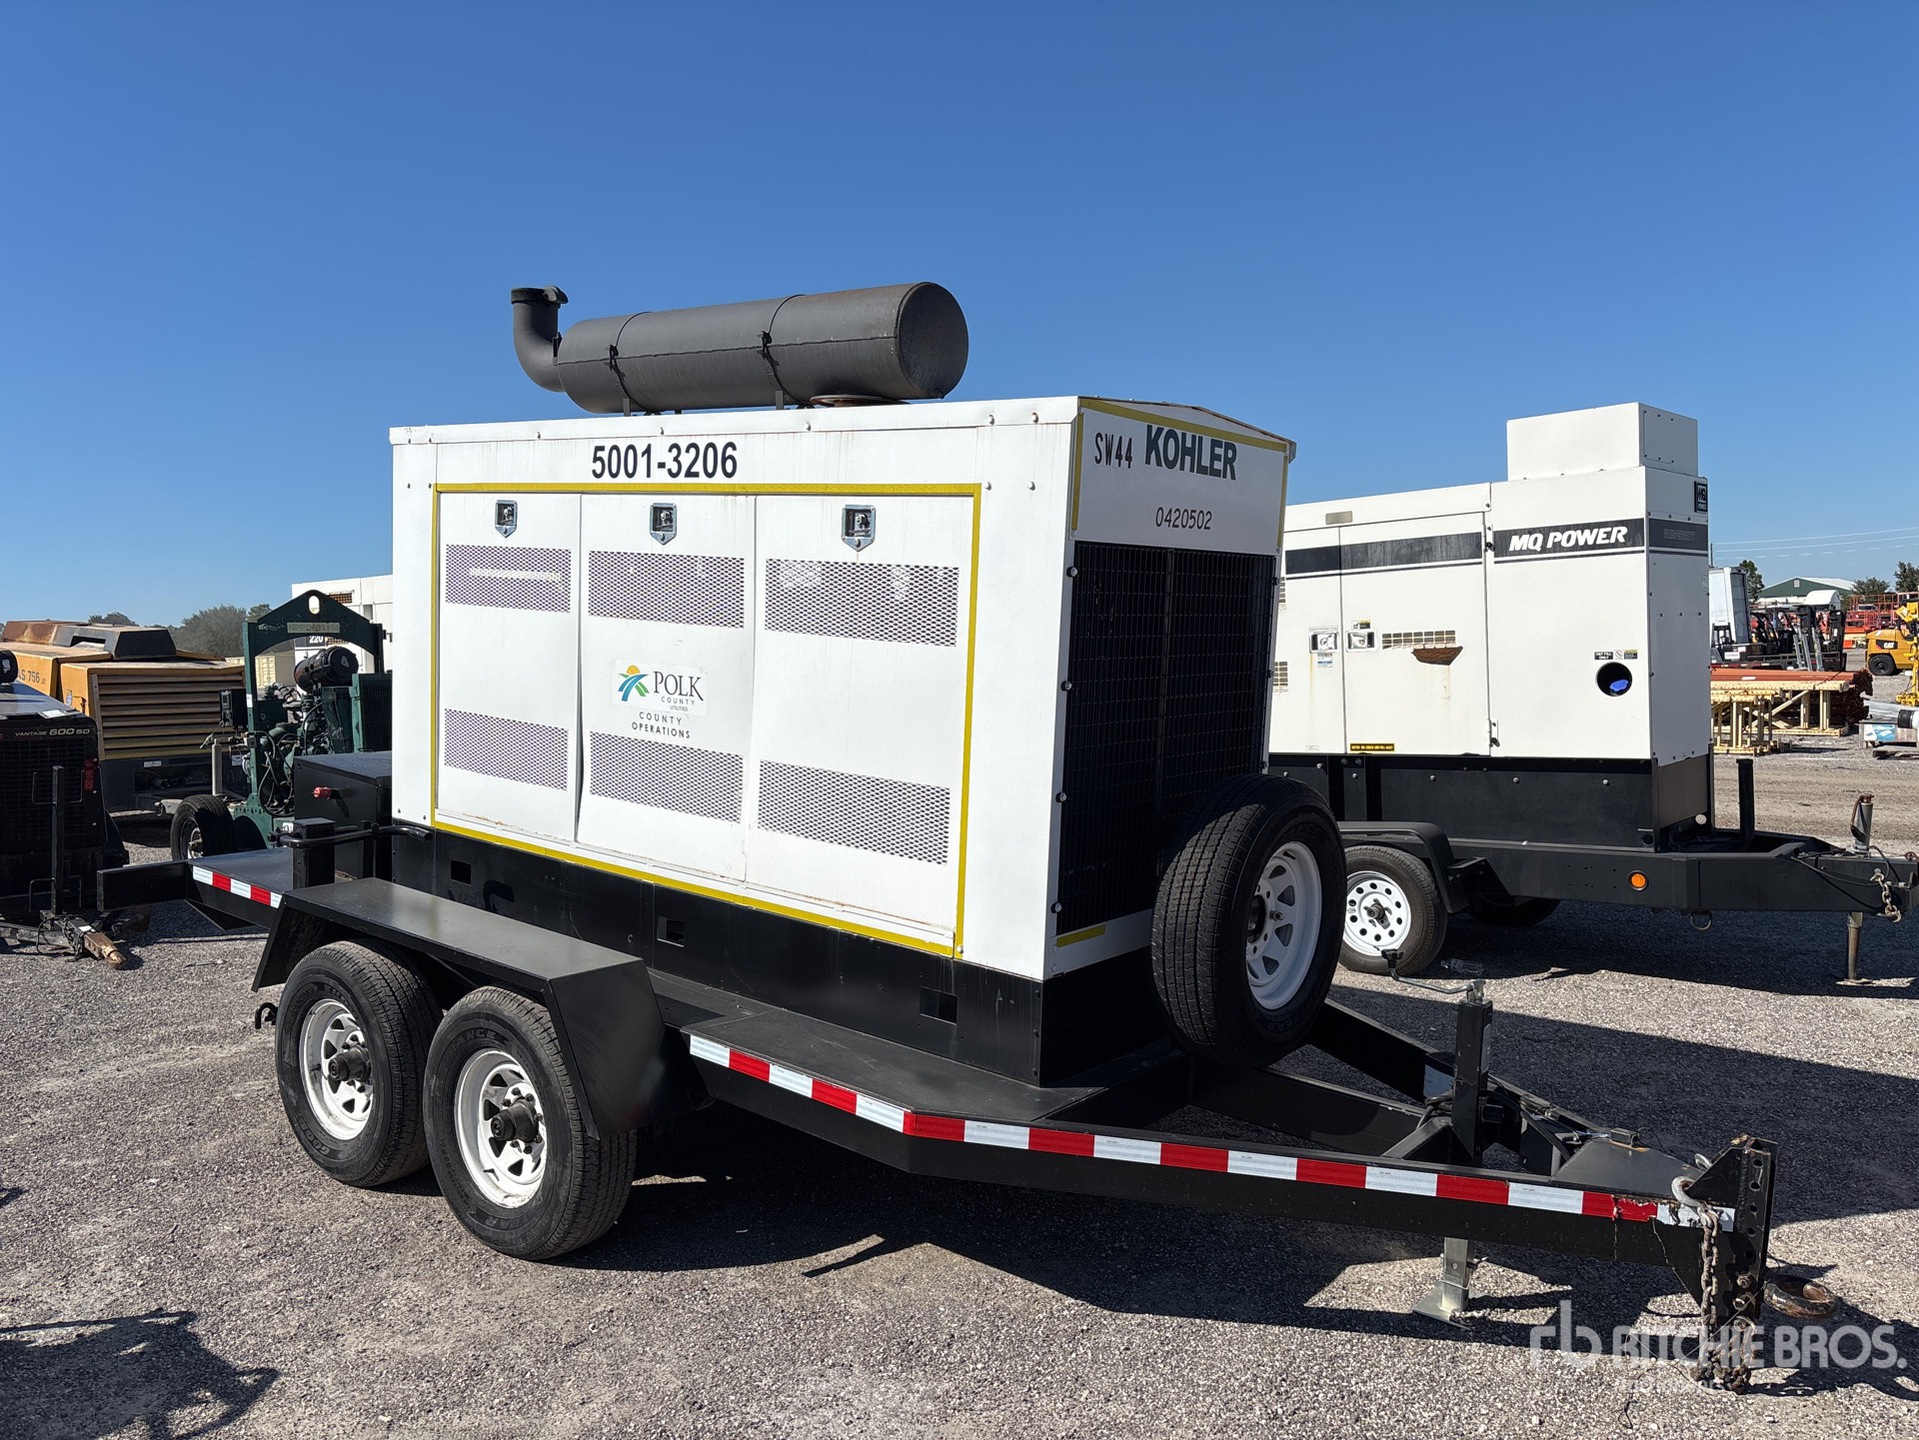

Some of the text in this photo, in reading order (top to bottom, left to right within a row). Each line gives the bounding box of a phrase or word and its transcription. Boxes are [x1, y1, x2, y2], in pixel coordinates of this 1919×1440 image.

[591, 441, 738, 479] 5001-3206
[1094, 432, 1133, 469] SW44
[1145, 424, 1237, 481] KOHLER
[1155, 506, 1213, 530] 0420502
[1508, 526, 1628, 552] MQ POWER
[27, 671, 40, 684] 756
[653, 671, 704, 701] POLK
[661, 696, 695, 706] COUNTY
[631, 721, 691, 739] OPERATIONS
[639, 711, 682, 725] COUNTY
[49, 727, 75, 736] 600
